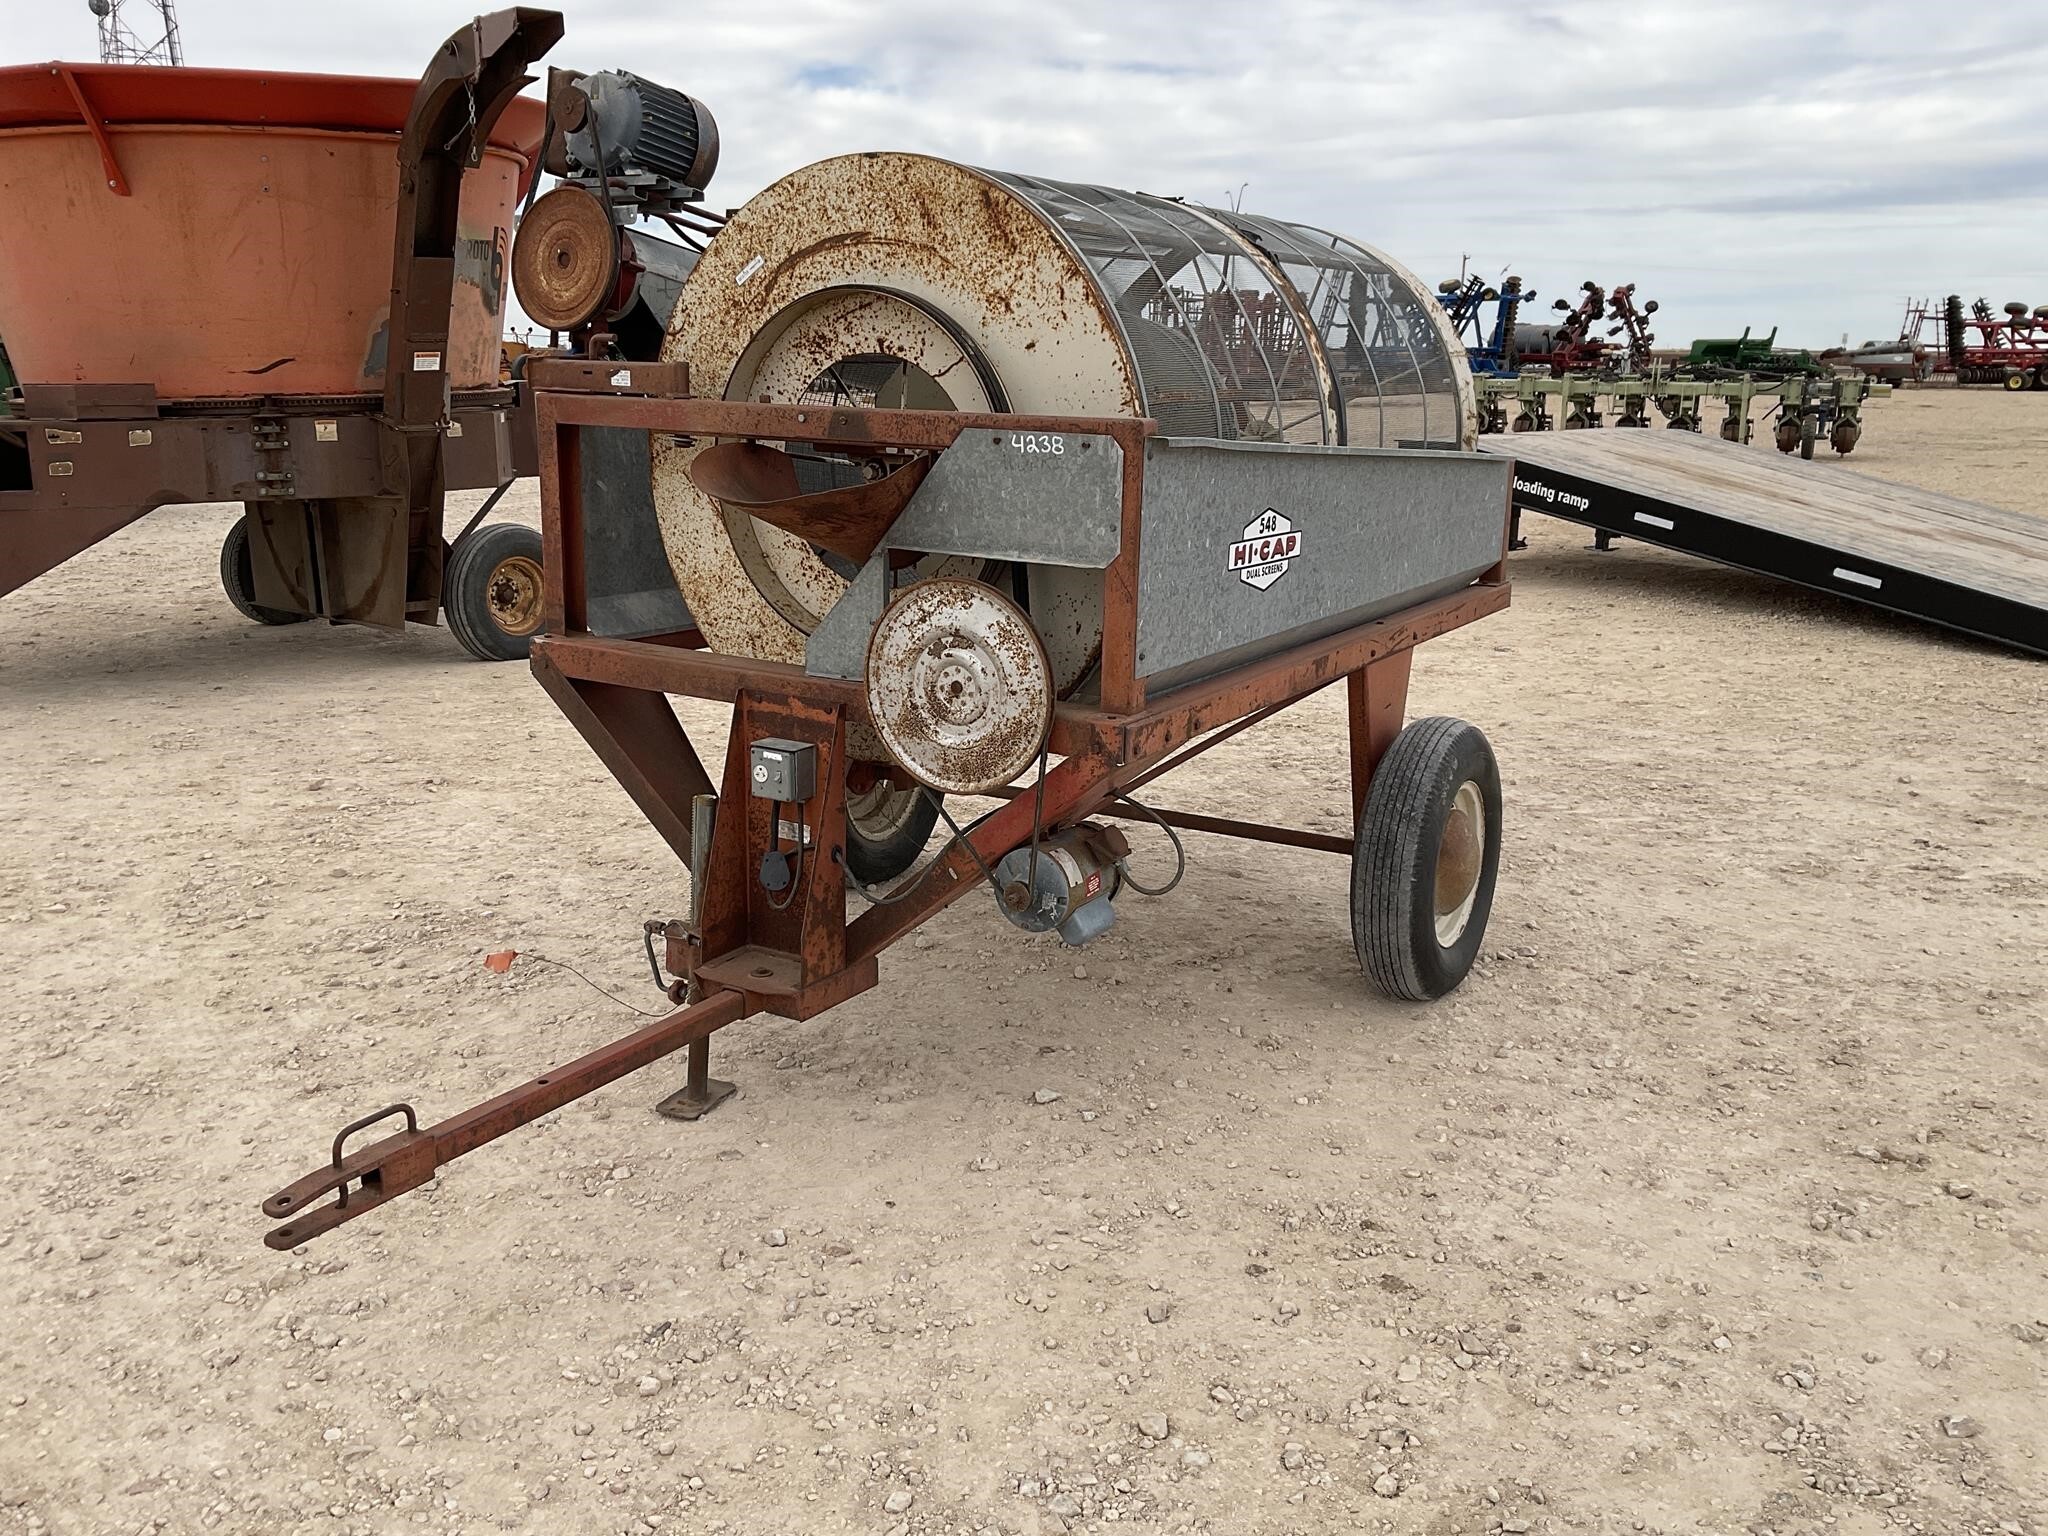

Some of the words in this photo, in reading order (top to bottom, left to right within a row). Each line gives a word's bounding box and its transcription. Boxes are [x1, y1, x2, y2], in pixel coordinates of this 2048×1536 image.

[1011, 434, 1065, 455] 4238
[1512, 475, 1556, 502] loading
[1557, 490, 1590, 511] ramp
[1259, 515, 1277, 534] 548
[1246, 569, 1261, 580] DUAL
[1261, 562, 1284, 576] SCREENS
